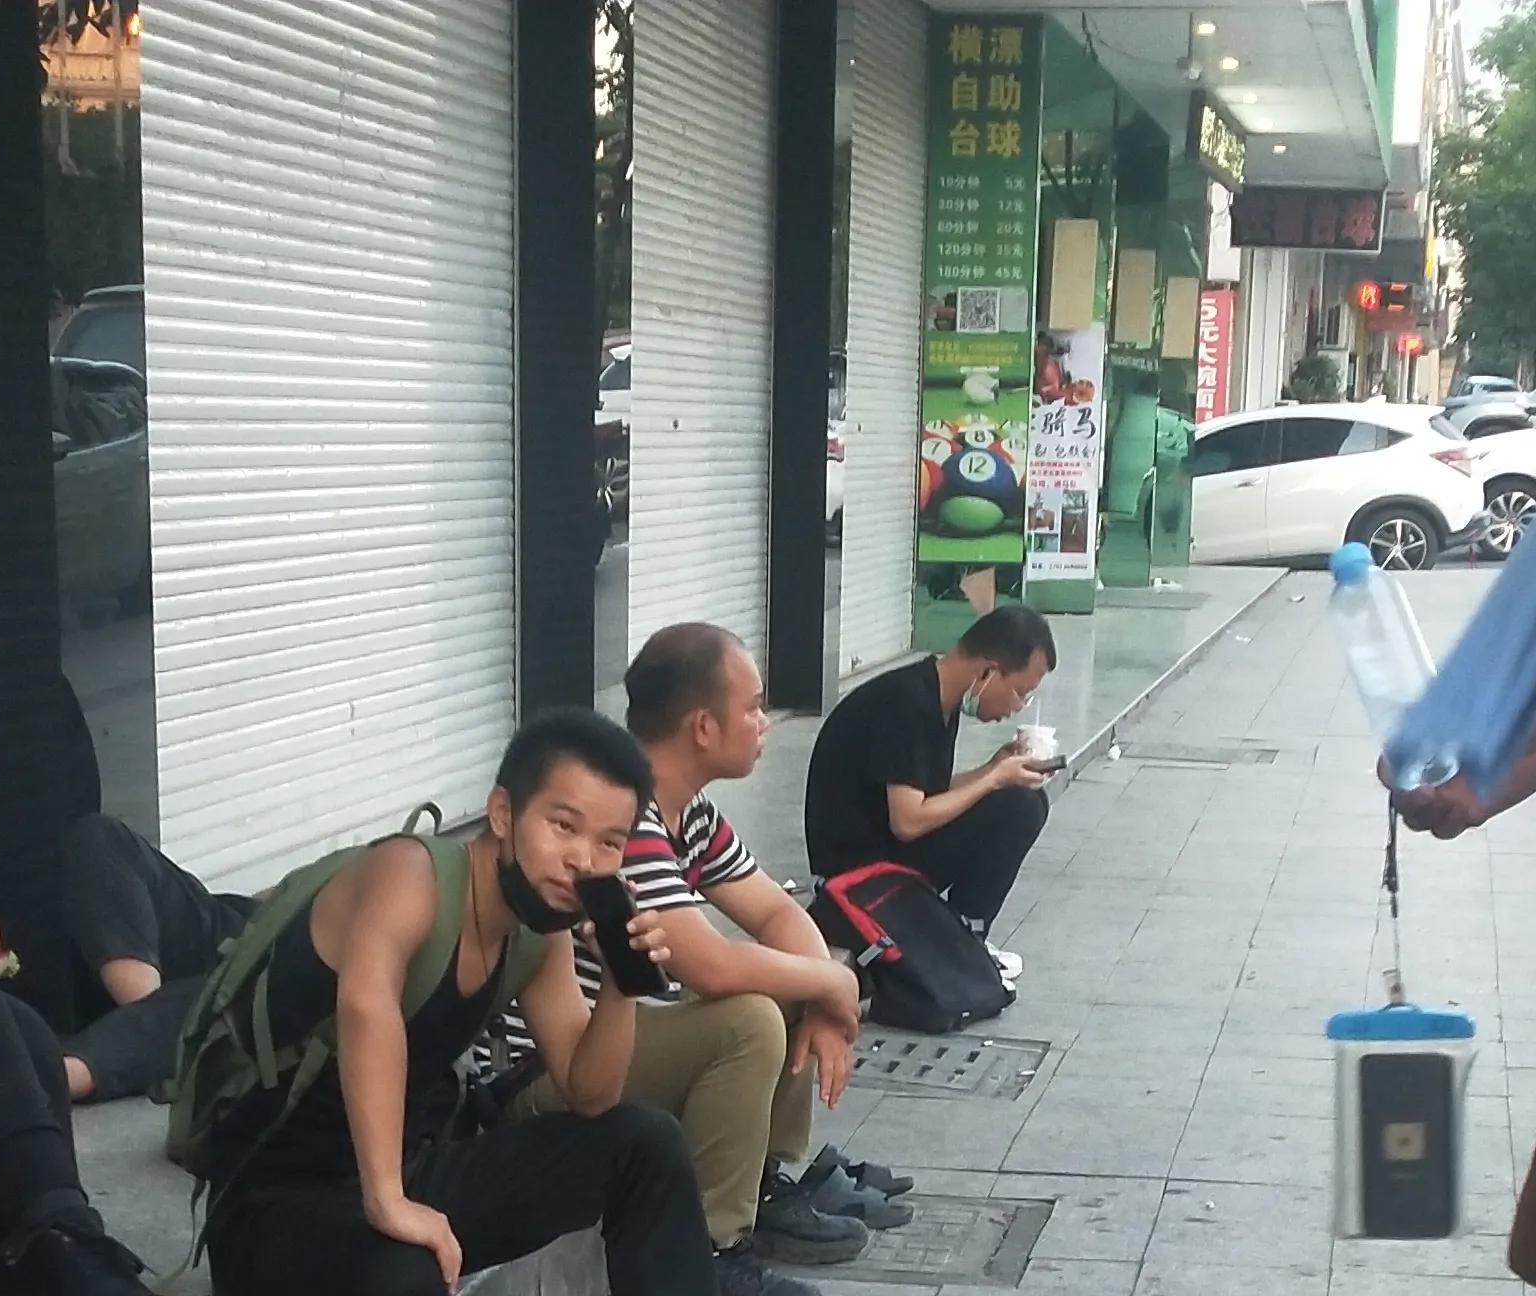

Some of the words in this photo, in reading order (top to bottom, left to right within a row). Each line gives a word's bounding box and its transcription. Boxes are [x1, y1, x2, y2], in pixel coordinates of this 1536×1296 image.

[951, 72, 1021, 111] 自助
[950, 119, 1021, 158] 台球
[938, 243, 986, 257] 120分钟
[938, 265, 985, 279] 180分钟
[968, 455, 988, 474] 12
